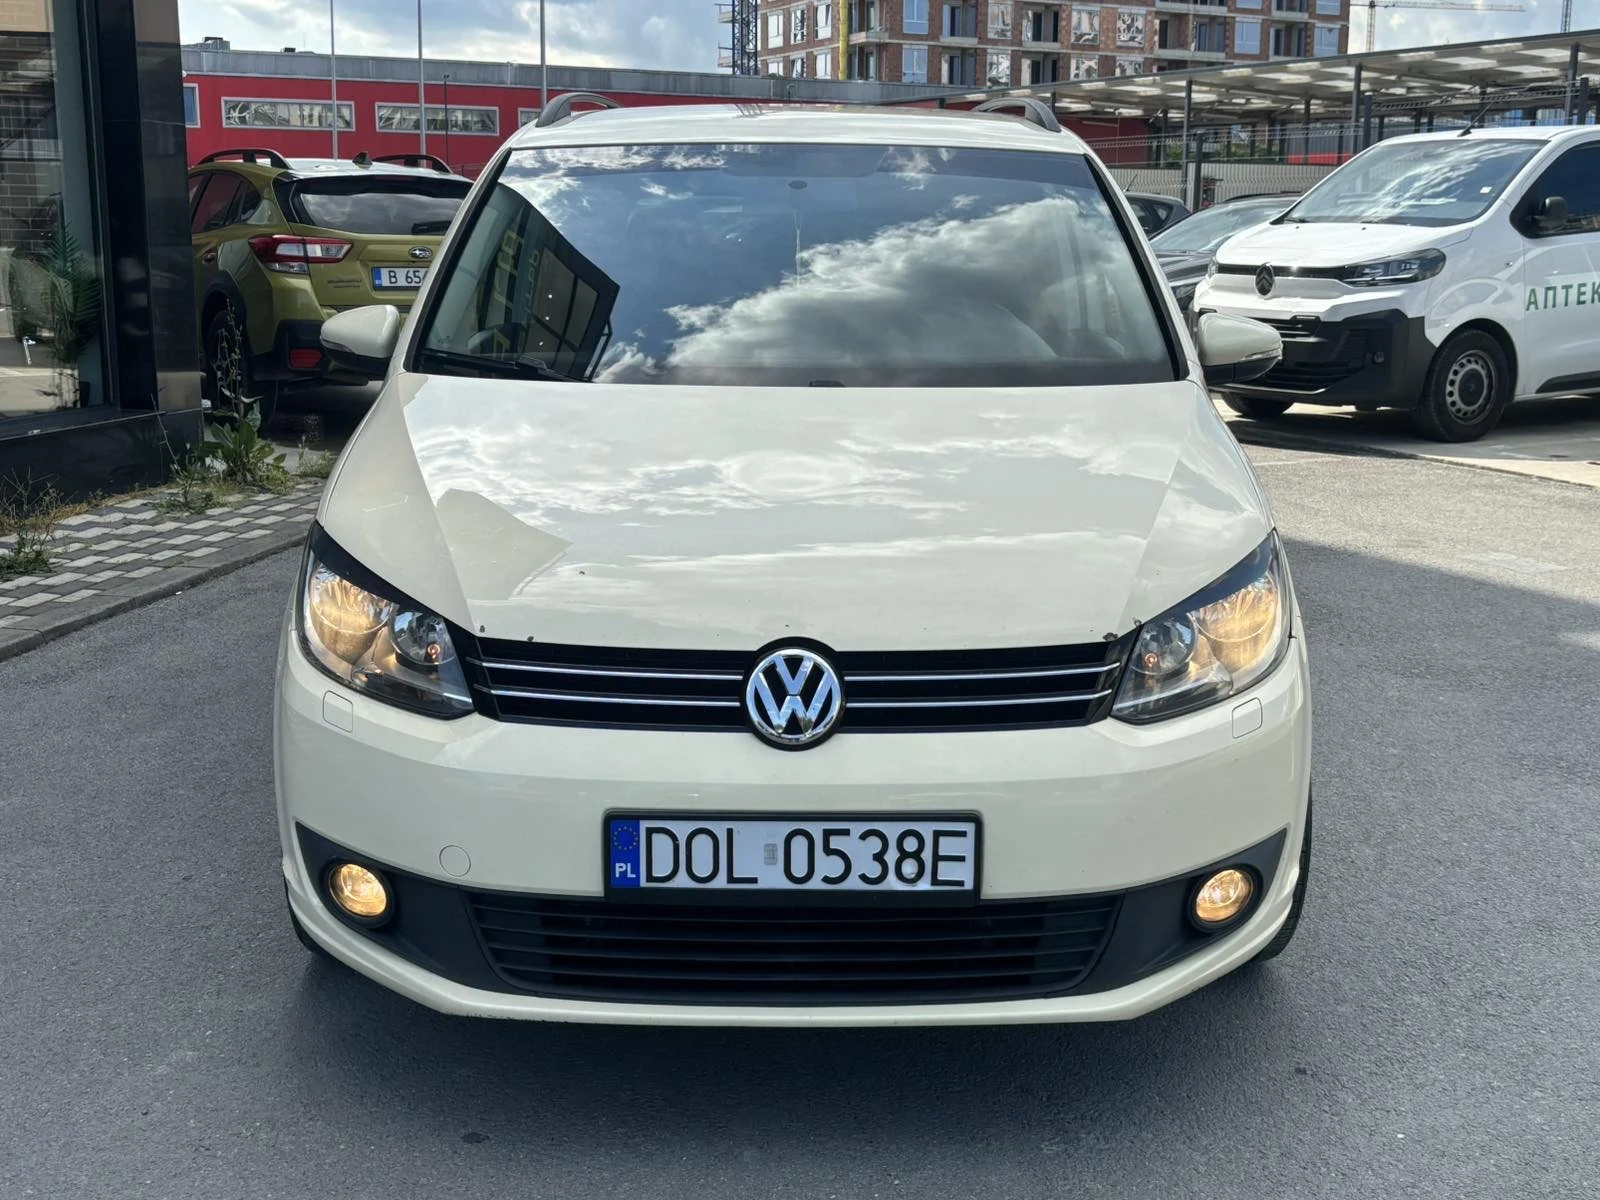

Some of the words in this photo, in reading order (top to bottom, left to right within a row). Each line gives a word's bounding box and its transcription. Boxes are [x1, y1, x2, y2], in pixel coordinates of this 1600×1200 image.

[388, 270, 398, 285] B
[405, 270, 428, 285] 65
[1525, 281, 1600, 311] АПТЕК
[748, 651, 839, 741] VW
[615, 862, 637, 878] PL
[645, 826, 759, 884] DOL
[783, 827, 968, 888] 0538E
